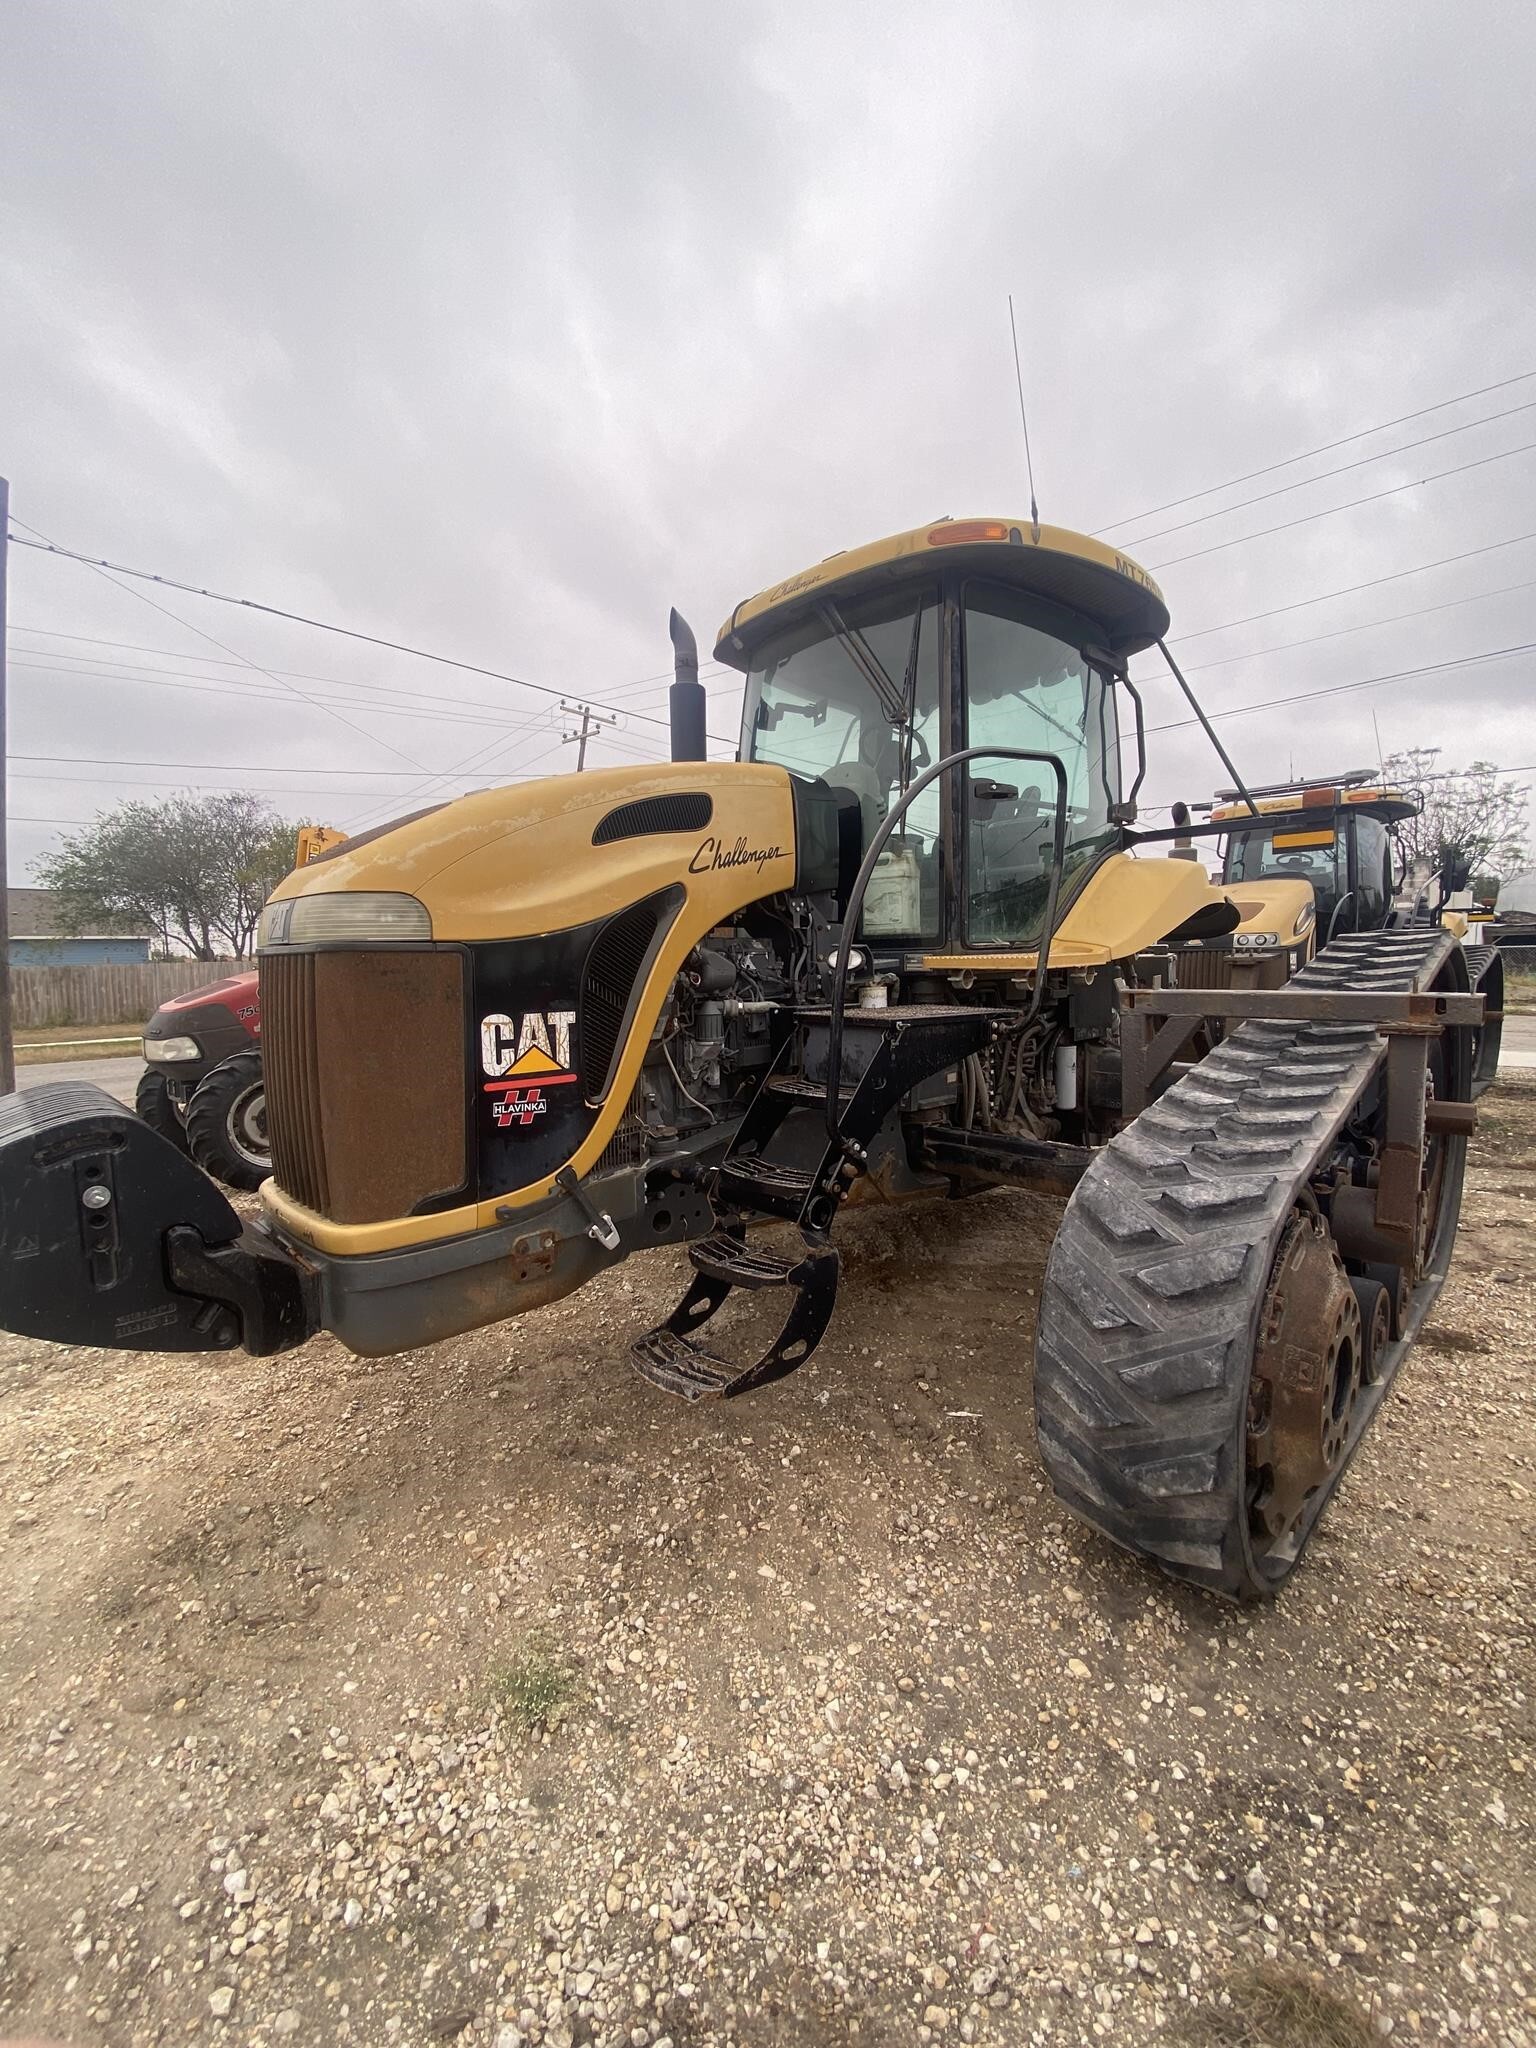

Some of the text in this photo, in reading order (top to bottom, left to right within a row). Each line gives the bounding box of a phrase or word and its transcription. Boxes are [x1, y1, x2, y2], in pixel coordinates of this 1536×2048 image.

[688, 836, 794, 874] Challenger
[481, 1011, 576, 1077] CAT
[494, 1101, 545, 1115] HLAVINKA
